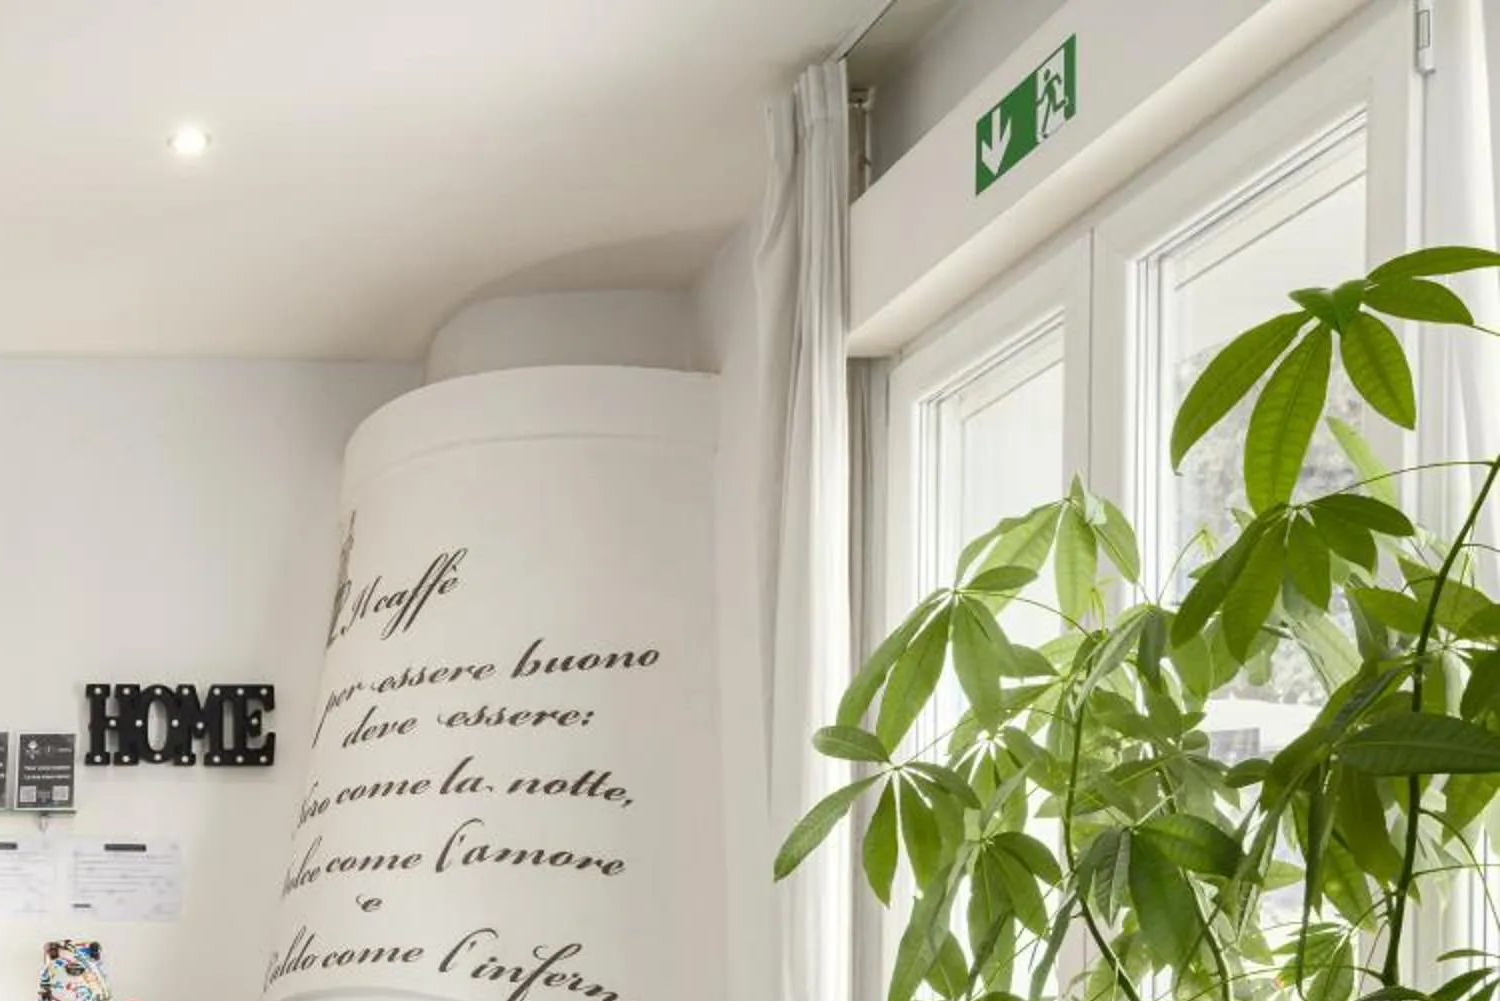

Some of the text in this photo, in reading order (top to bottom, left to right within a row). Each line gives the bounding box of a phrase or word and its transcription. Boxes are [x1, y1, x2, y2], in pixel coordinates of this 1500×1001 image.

[372, 547, 469, 641] caffè
[311, 637, 661, 749] per essere buono
[84, 684, 277, 767] HOME
[341, 704, 595, 749] deve essere:
[336, 777, 432, 806] come
[439, 755, 496, 798] la
[506, 768, 635, 809] notte,
[325, 852, 423, 874] come
[435, 818, 627, 878] l'amore
[356, 892, 384, 914] e
[321, 945, 426, 969] come
